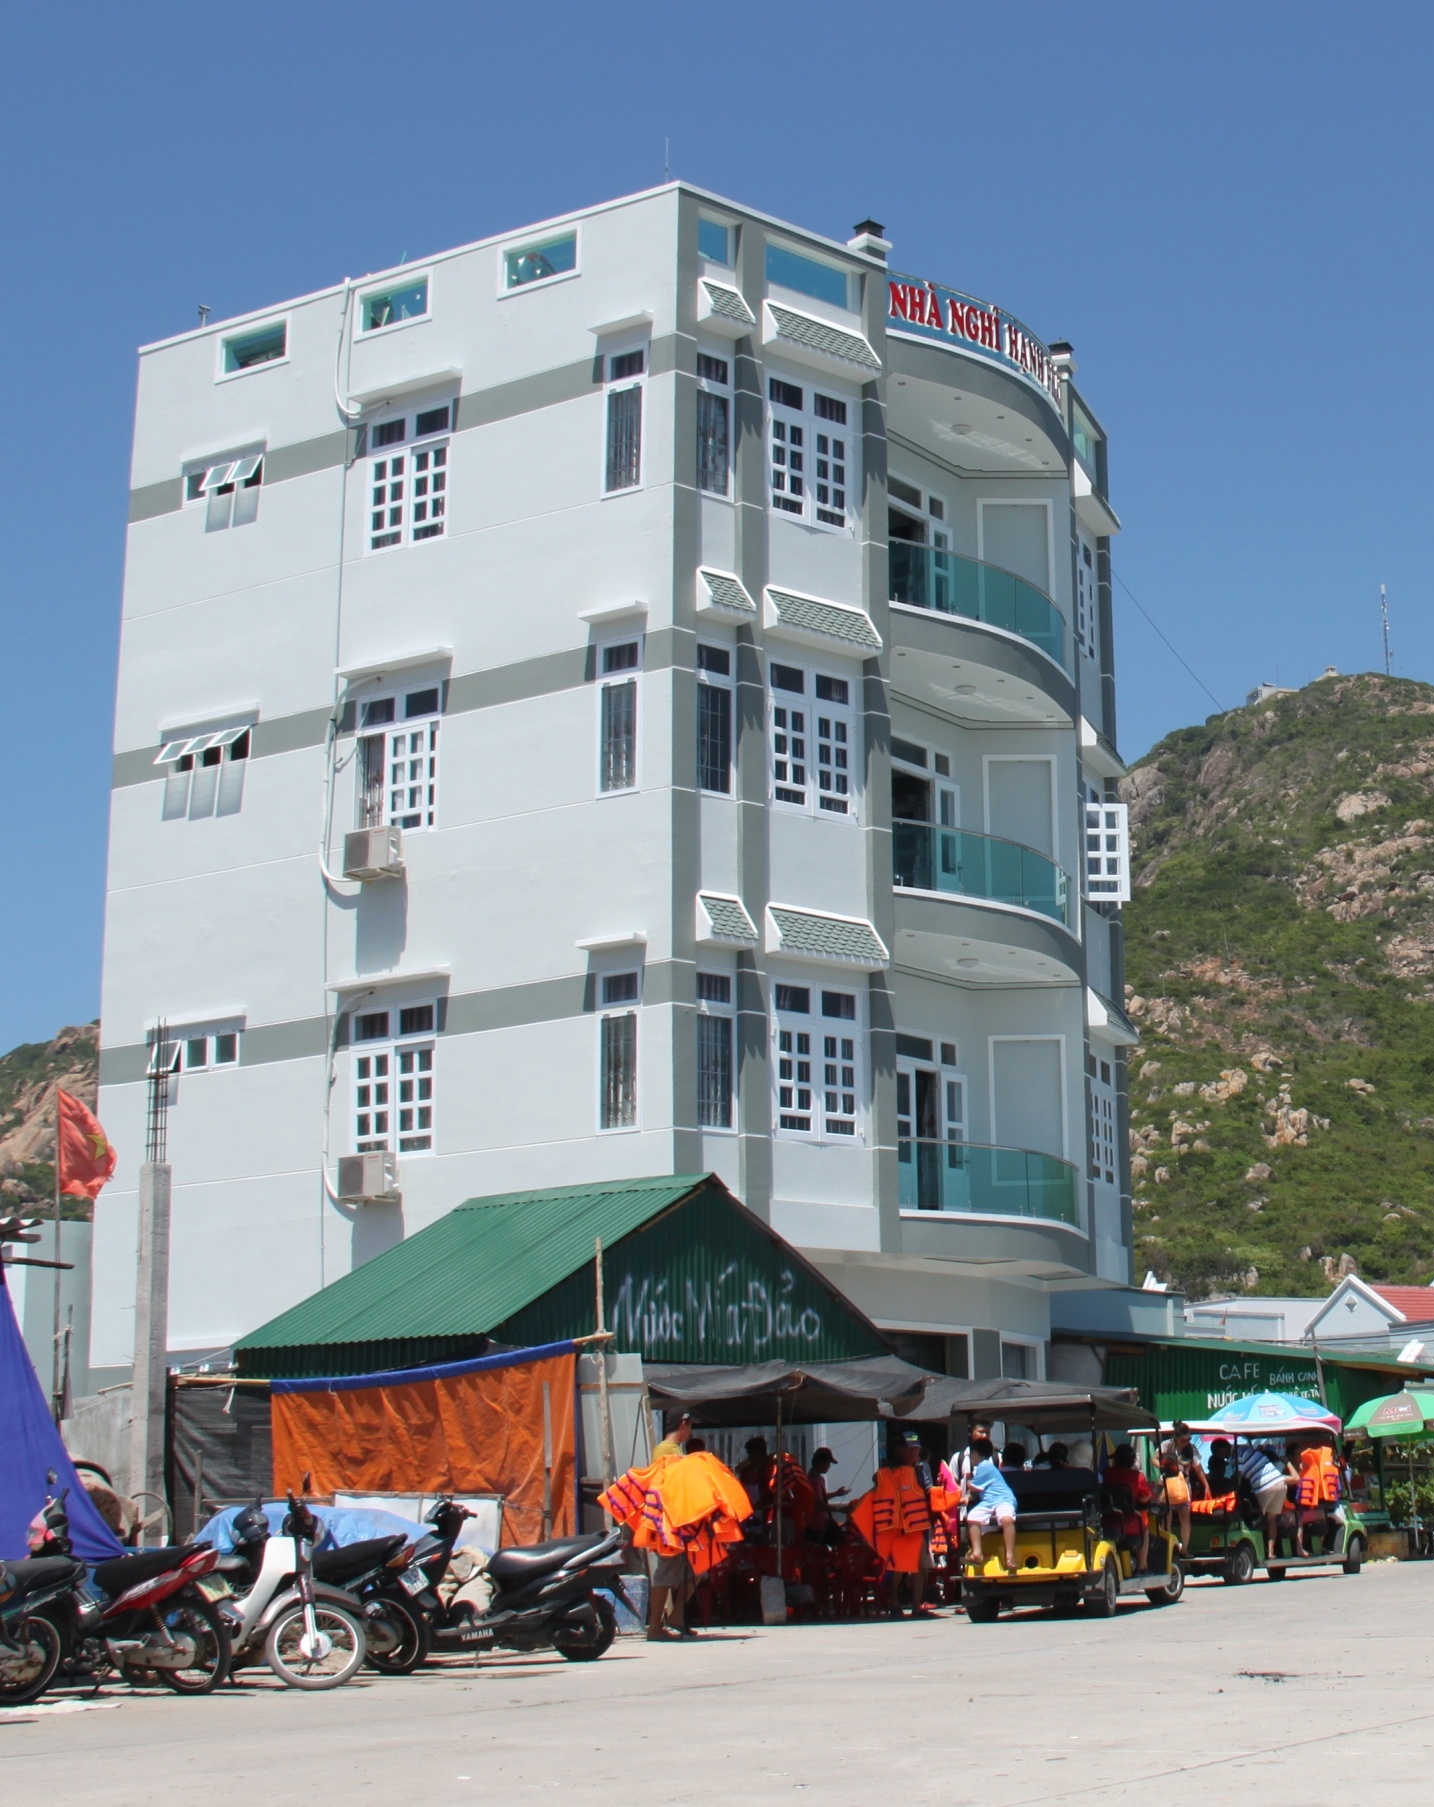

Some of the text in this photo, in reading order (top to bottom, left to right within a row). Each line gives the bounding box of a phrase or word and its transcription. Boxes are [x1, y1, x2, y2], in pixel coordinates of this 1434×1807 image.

[888, 280, 943, 329] NHÀ
[947, 299, 1003, 352] NGHỈ
[1219, 1362, 1260, 1380] CAFE
[1269, 1366, 1295, 1386] BÁNH
[460, 1627, 494, 1642] YAMAHA
